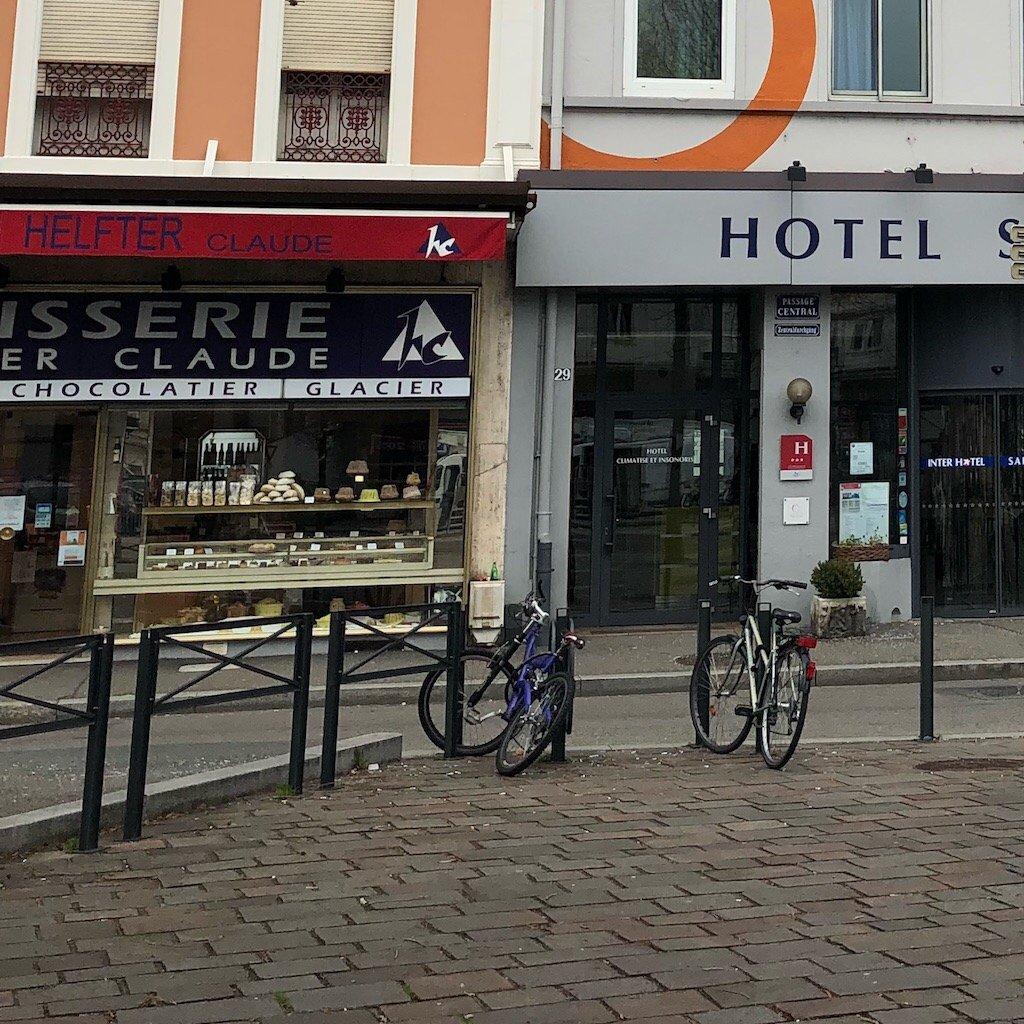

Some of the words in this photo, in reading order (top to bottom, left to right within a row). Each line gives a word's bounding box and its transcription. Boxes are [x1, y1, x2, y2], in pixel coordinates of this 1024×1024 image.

[23, 214, 184, 251] HELFTER
[206, 232, 334, 254] CLAUDE
[720, 217, 942, 260] HOTEL
[782, 297, 815, 306] PASSAGE
[0, 299, 331, 339] ISSERIE
[777, 307, 818, 316] CENTRAL
[1, 347, 59, 371] ER
[114, 347, 329, 370] CLAUDE
[554, 368, 571, 381] 29
[12, 381, 258, 398] CHOCOLATIER
[306, 381, 444, 396] GLACIER
[795, 441, 809, 455] H
[927, 458, 953, 468] INTER
